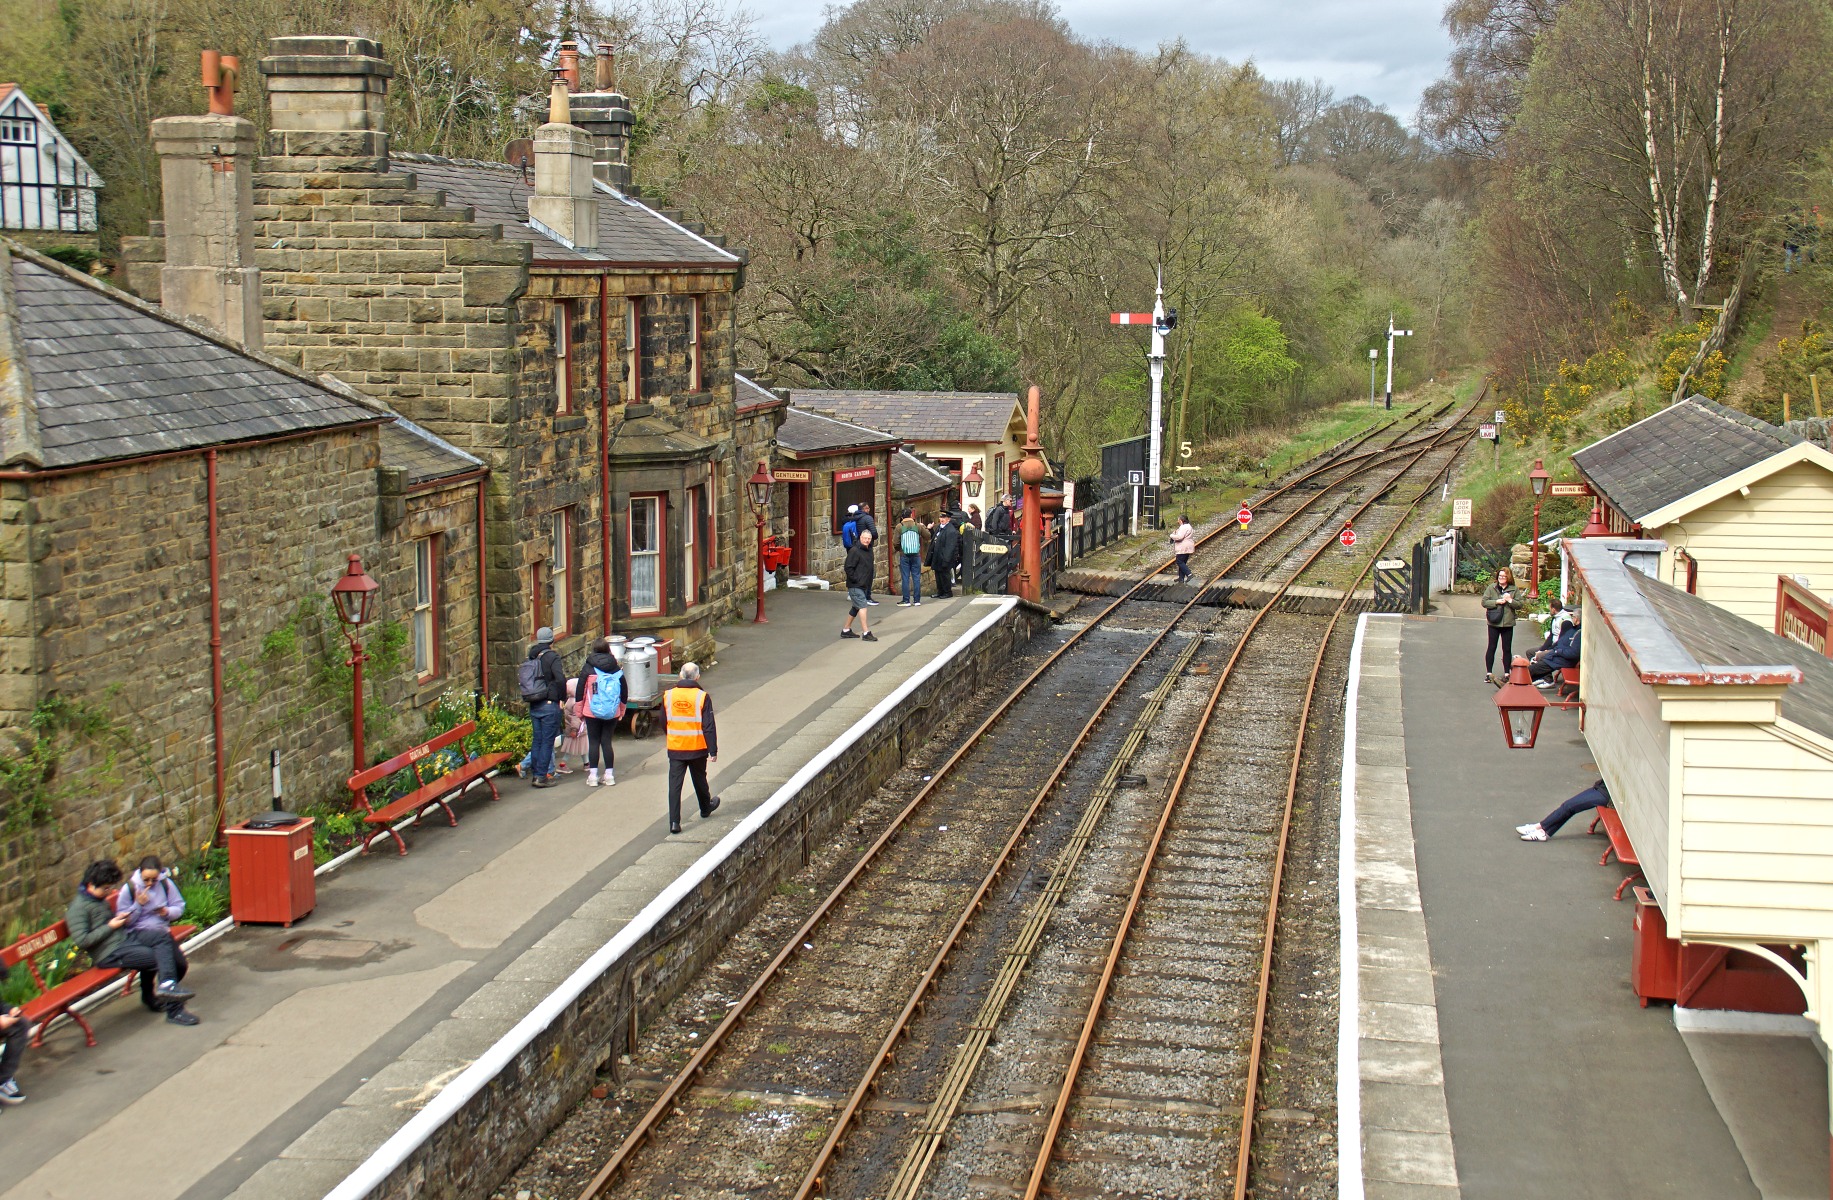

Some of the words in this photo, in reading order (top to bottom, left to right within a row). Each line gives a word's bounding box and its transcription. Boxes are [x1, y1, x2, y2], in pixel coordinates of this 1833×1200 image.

[1180, 441, 1192, 458] 5
[1132, 473, 1140, 482] B
[409, 744, 430, 760] GOATHLAND
[17, 929, 58, 958] GOATHLAND
